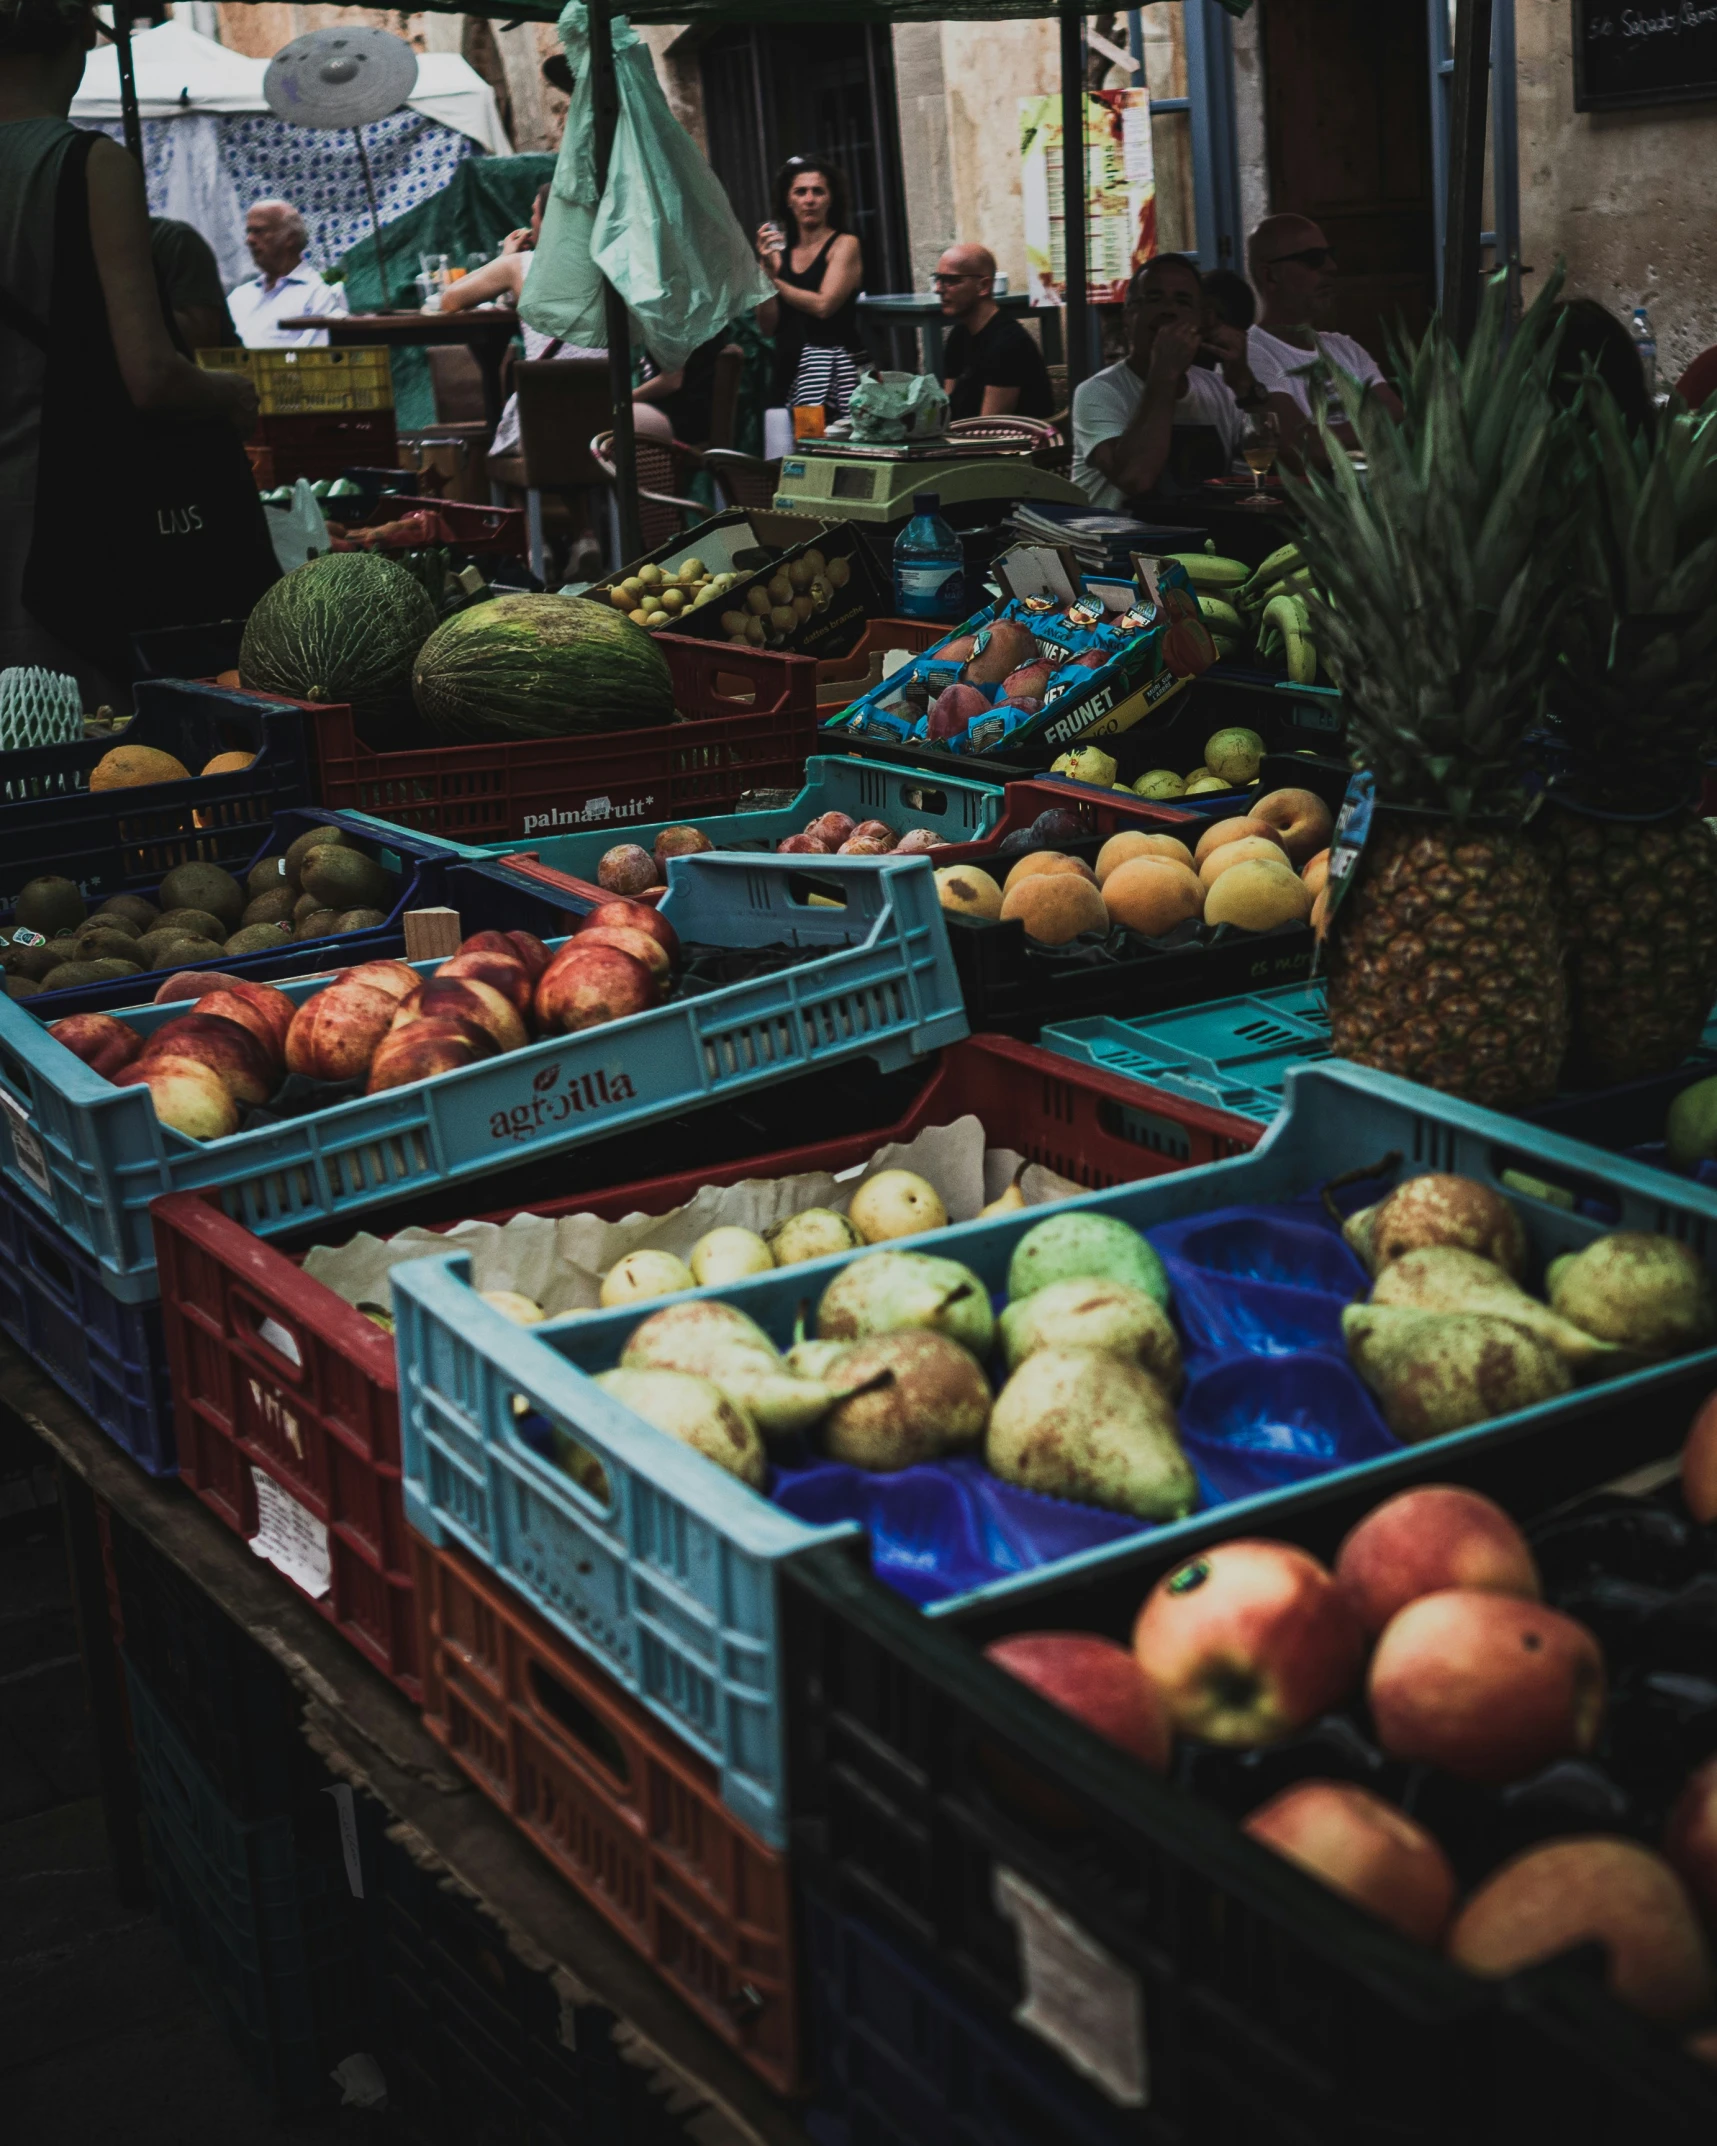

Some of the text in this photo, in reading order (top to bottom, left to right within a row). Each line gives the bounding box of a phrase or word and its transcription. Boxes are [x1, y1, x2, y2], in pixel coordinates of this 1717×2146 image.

[803, 604, 865, 645] dattes branche
[1043, 686, 1114, 744] FRUNET
